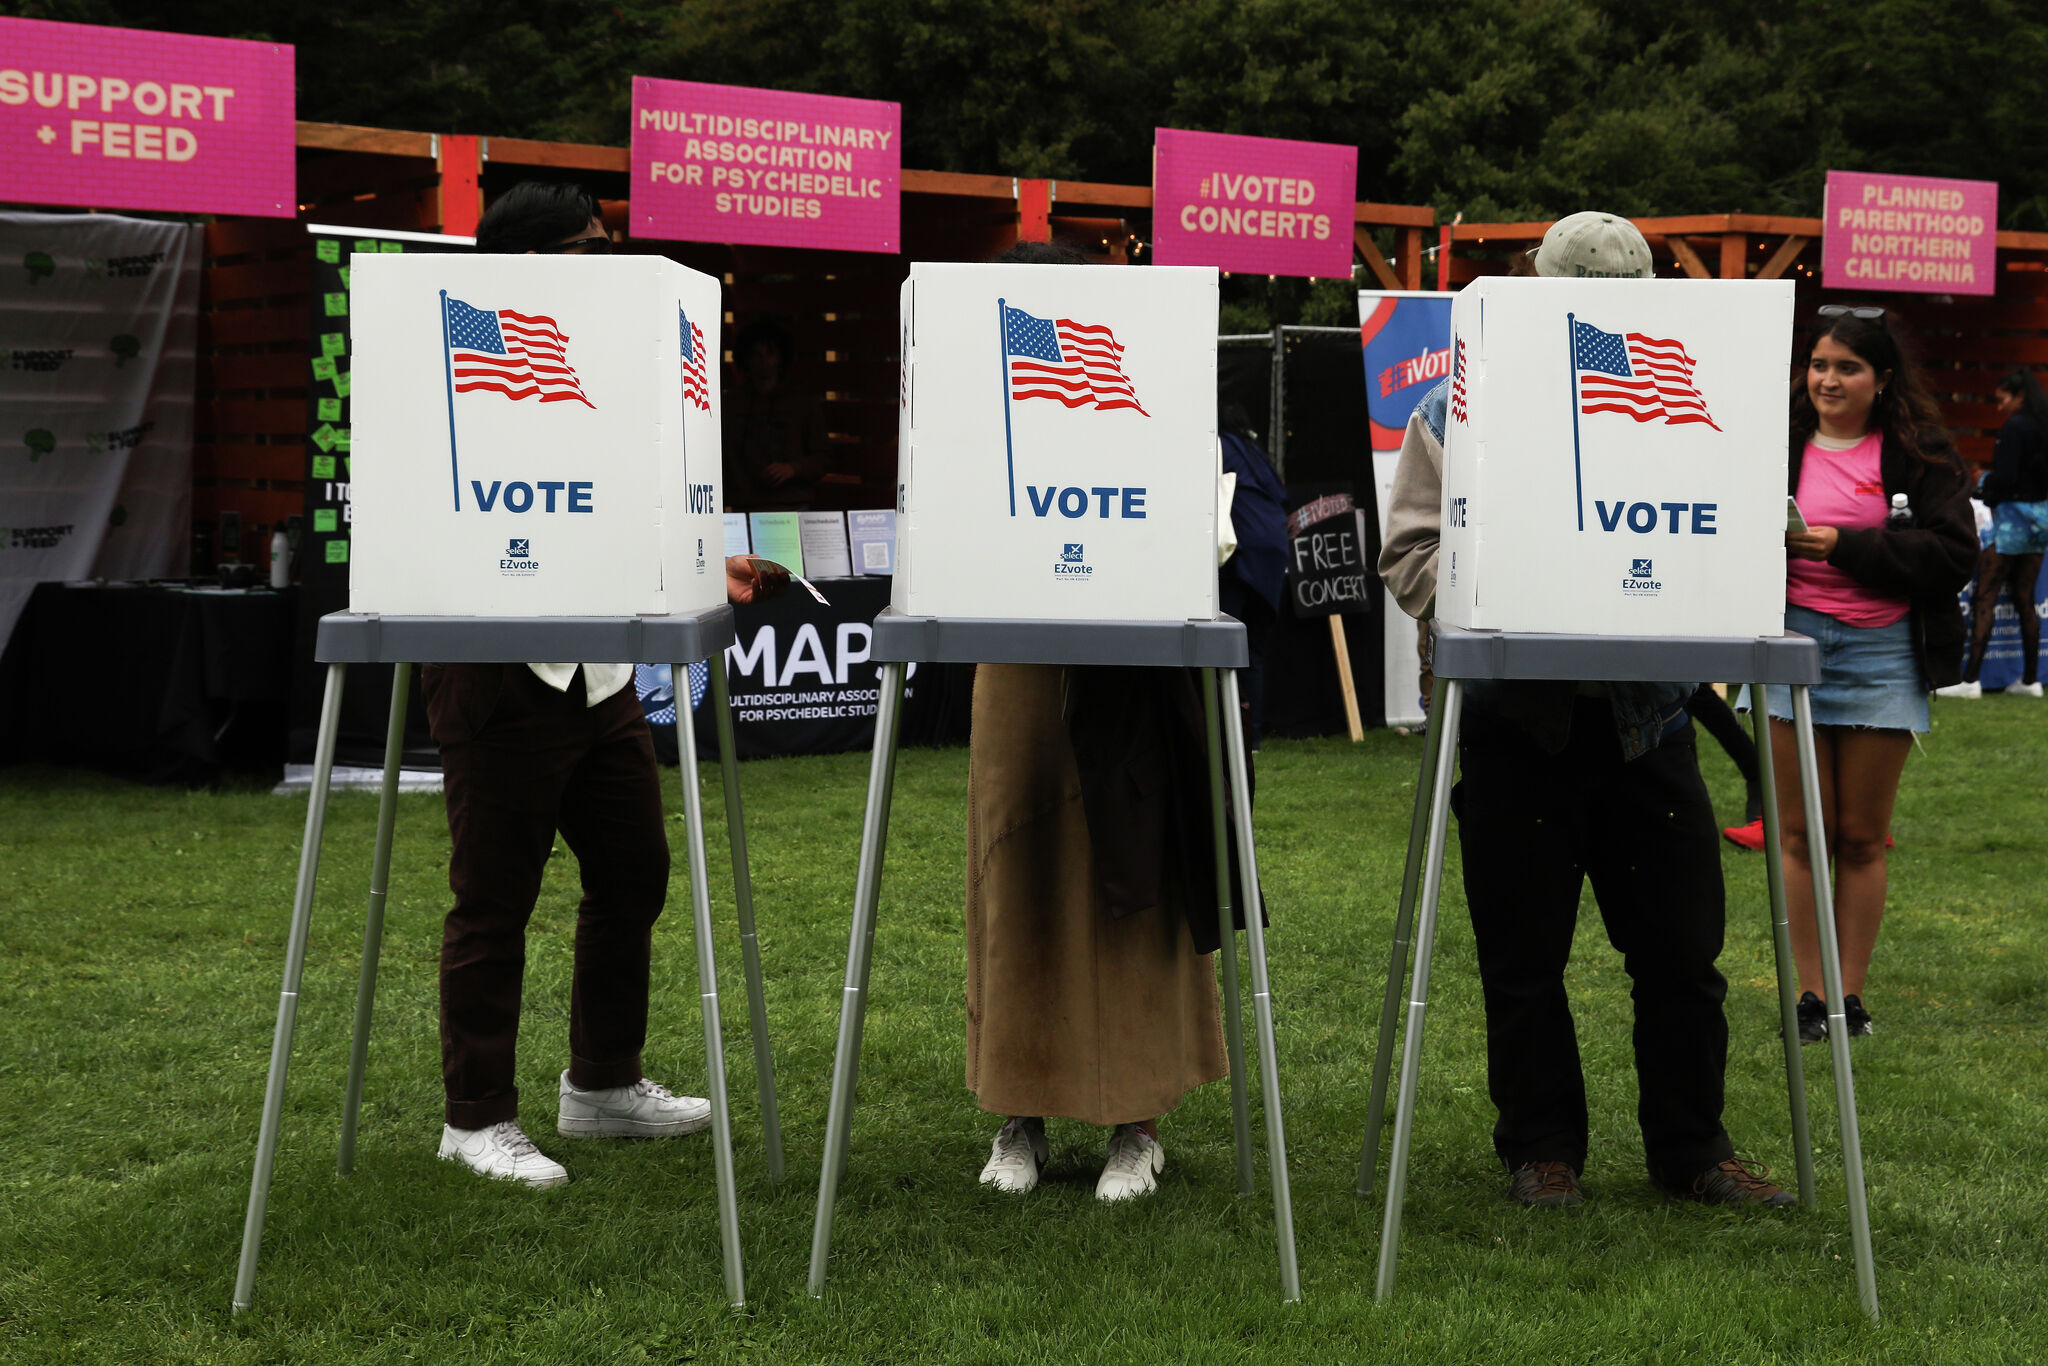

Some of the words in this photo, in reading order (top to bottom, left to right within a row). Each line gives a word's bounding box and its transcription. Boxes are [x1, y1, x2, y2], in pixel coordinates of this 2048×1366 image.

[0, 70, 234, 121] SUPPORT
[37, 125, 56, 144] +
[71, 120, 197, 162] FEED
[640, 109, 892, 150] MULTIDISCIPLINARY
[684, 138, 852, 171] ASSOCIATION
[650, 162, 703, 185] FOR
[712, 166, 882, 198] PSYCHEDELIC
[1200, 172, 1315, 206] #IVOTED
[715, 193, 822, 219] STUDIES
[1863, 184, 1965, 211] PLANNED
[1180, 204, 1331, 240] CONCERTS
[1839, 207, 1985, 236] PARENTHOOD
[1851, 233, 1971, 259] NORTHERN
[1845, 258, 1975, 284] CALIFORNIA
[471, 480, 593, 513] VOTE
[689, 484, 713, 514] VOTE
[1026, 486, 1147, 519] VOTE
[1450, 498, 1466, 527] VOTE
[1595, 501, 1717, 534] VOTE
[12, 525, 74, 538] SUPPORT
[500, 559, 539, 570] EZvote
[505, 547, 529, 555] select
[1059, 552, 1083, 560] select
[1294, 533, 1355, 573] FREE
[1054, 563, 1093, 574] EZvote
[1628, 567, 1652, 575] select
[1298, 574, 1367, 607] CONCERT
[1622, 579, 1662, 590] EZvote
[730, 691, 835, 707] ULTIDISCIPLINARY
[739, 710, 764, 722] FOR
[766, 706, 846, 720] PSYCHEDELIC
[848, 705, 878, 717] STUD
